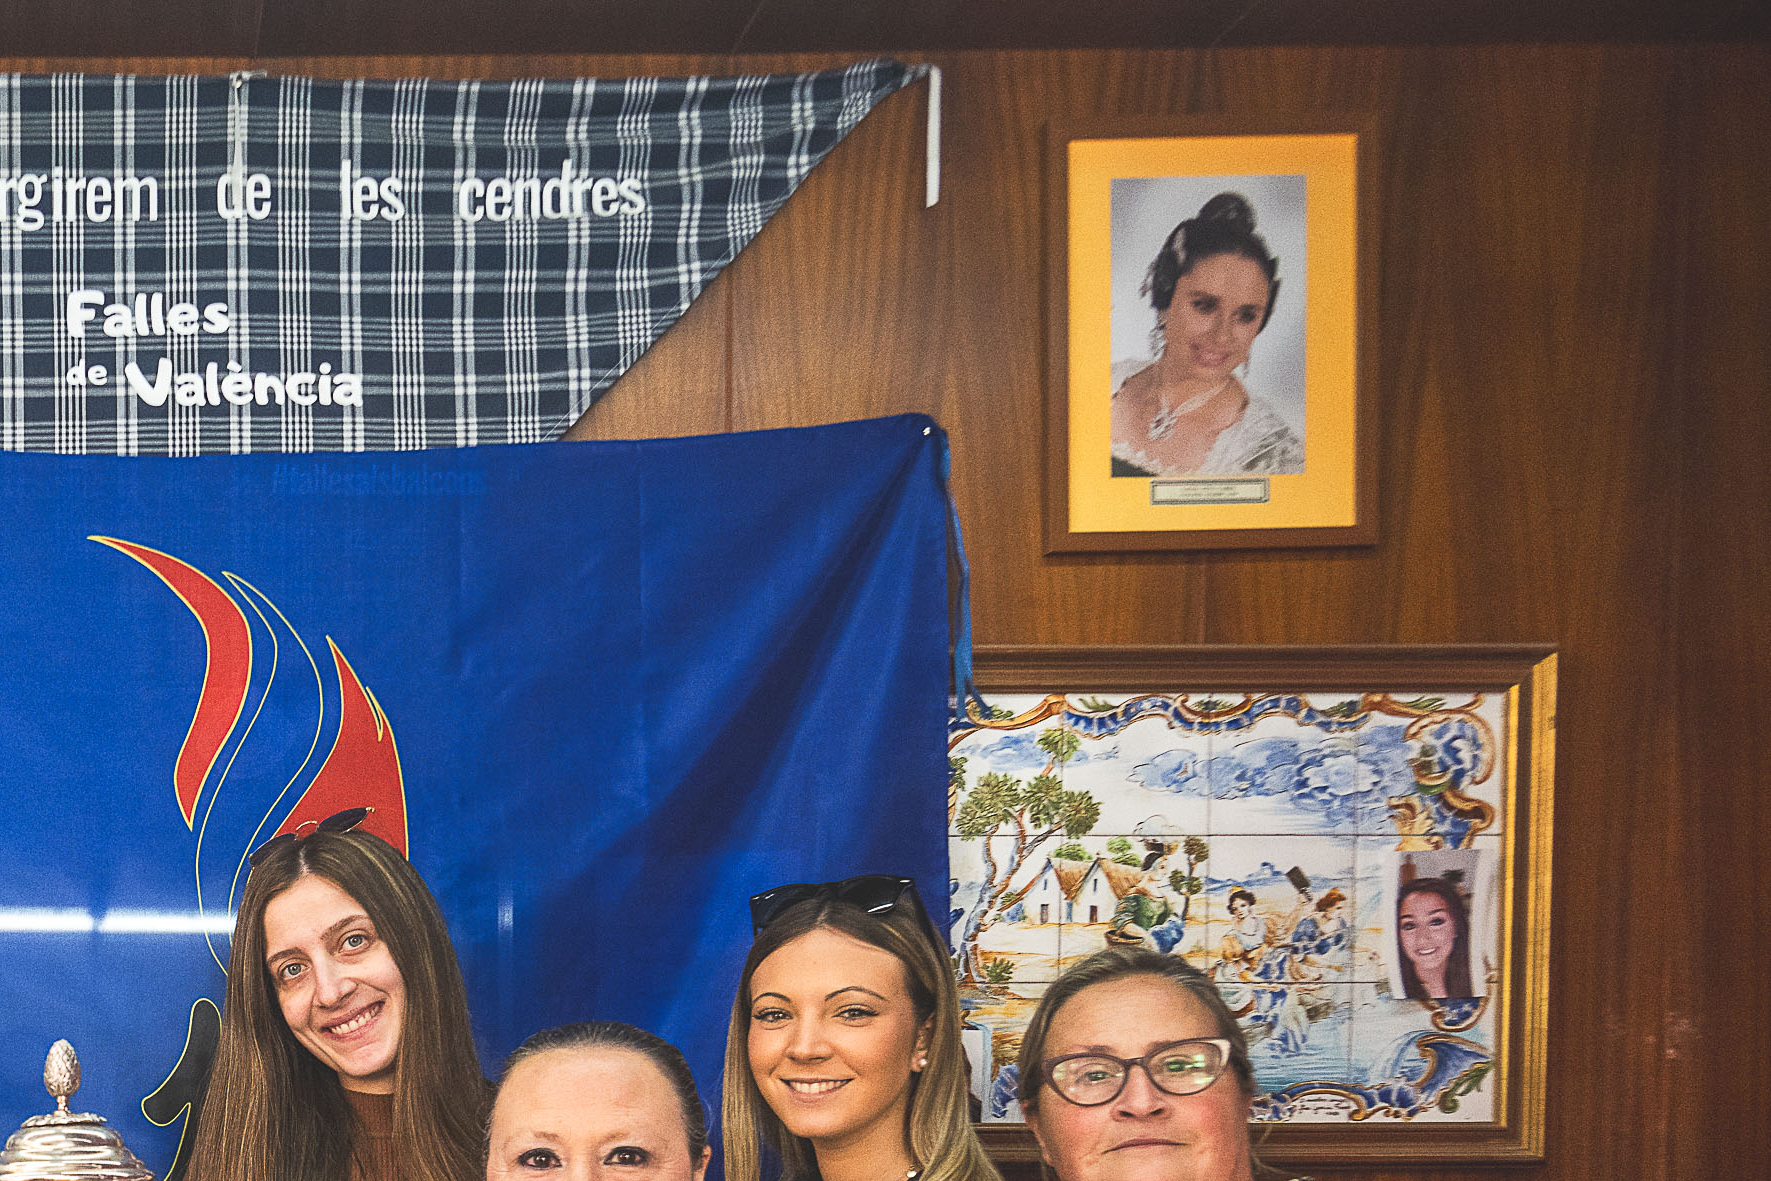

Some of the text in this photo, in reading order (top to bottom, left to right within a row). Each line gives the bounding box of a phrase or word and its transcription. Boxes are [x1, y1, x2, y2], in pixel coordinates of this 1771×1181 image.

[216, 159, 271, 220] de
[340, 158, 405, 222] les
[458, 158, 646, 222] cendres
[66, 289, 231, 338] Falles
[65, 356, 364, 407] de València
